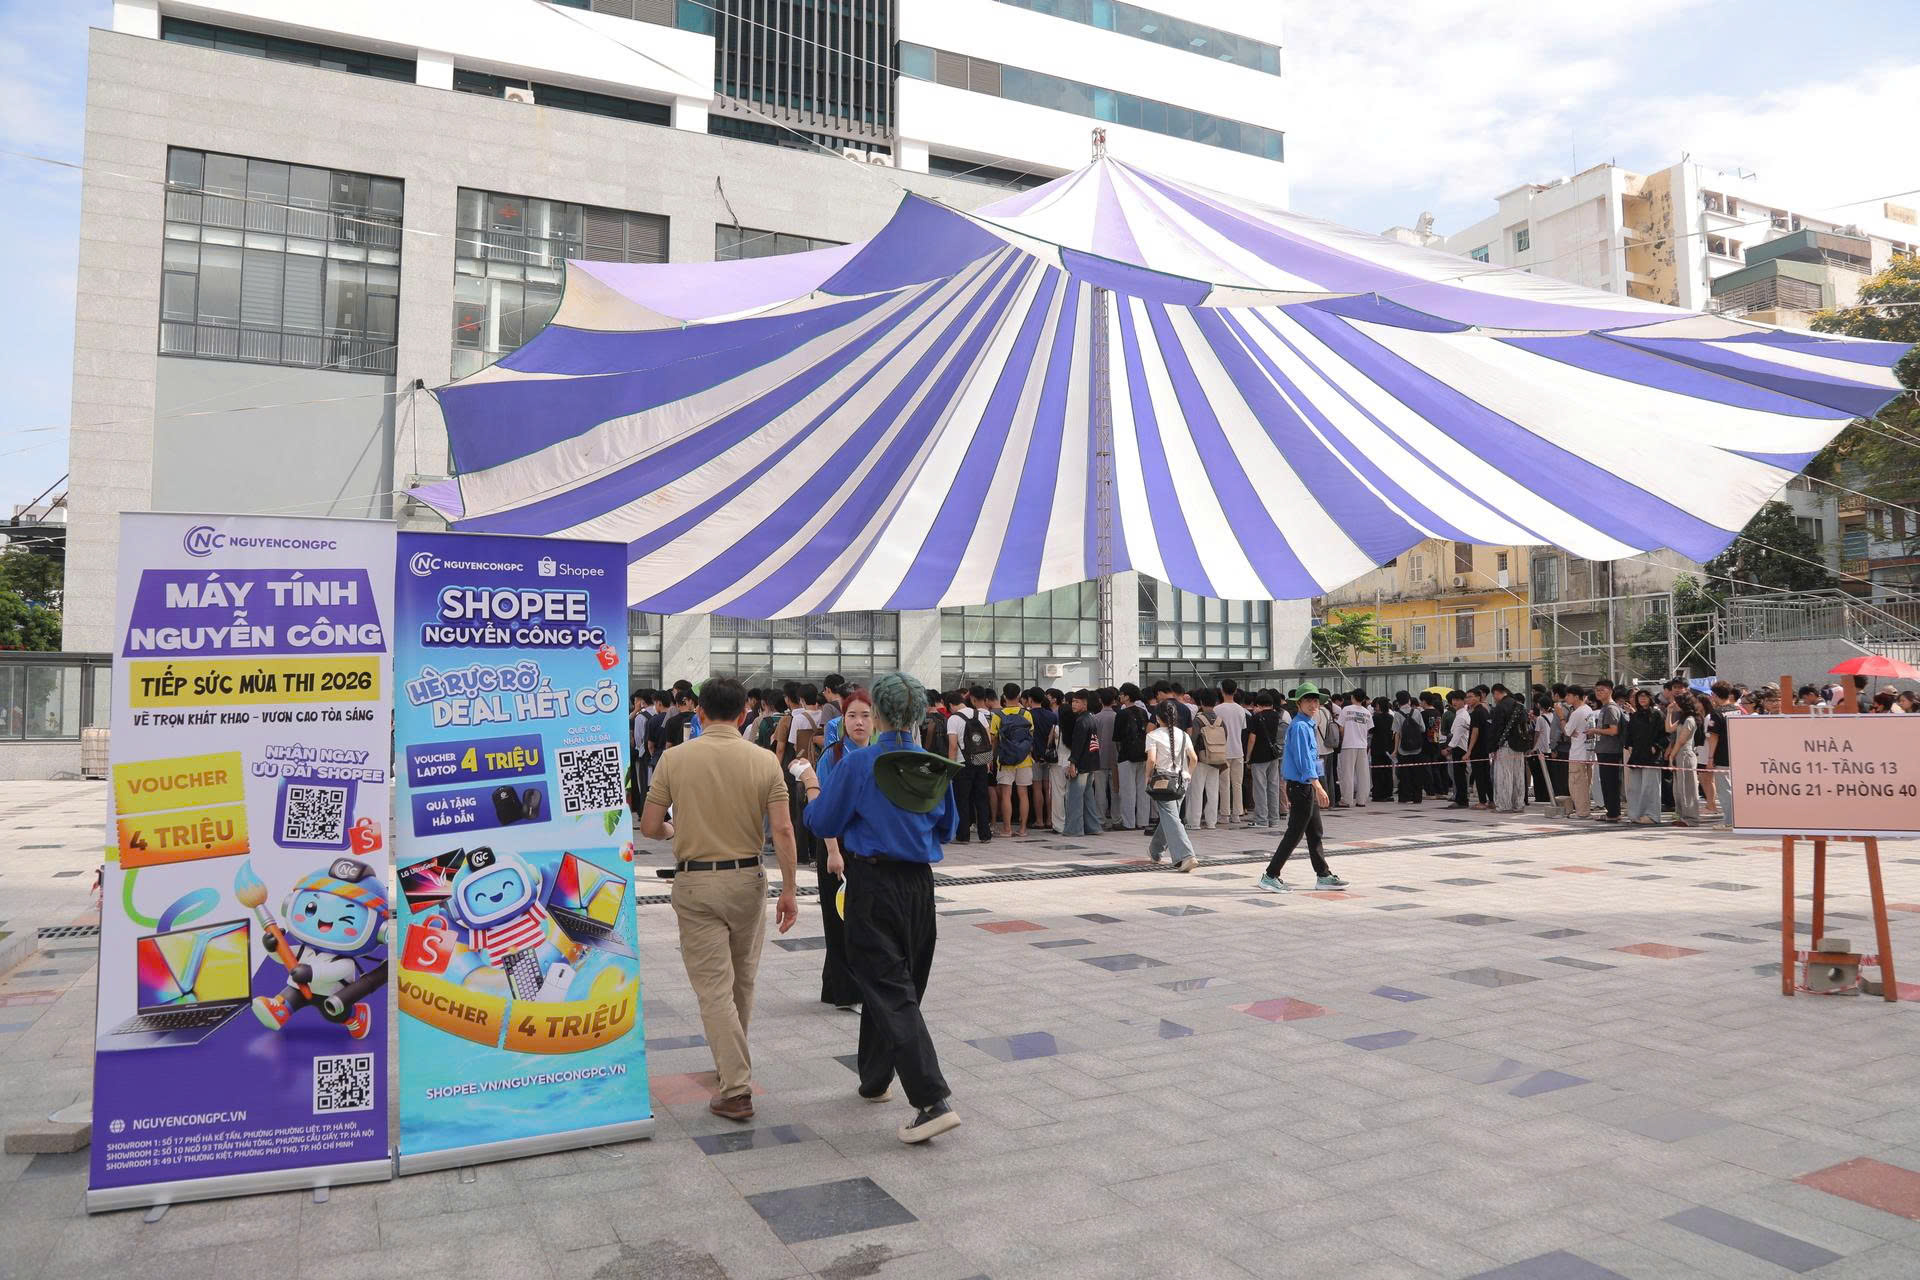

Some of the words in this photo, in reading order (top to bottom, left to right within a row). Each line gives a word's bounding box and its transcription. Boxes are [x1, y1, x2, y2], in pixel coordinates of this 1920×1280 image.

[230, 537, 337, 550] NGUYENCONGPC
[444, 560, 524, 572] NGUYENCONGPC
[559, 563, 605, 579] Shopee
[165, 572, 254, 609] MÁY
[267, 571, 358, 606] TÍNH
[442, 589, 587, 621] SHOPEE
[131, 610, 275, 650] NGUYỄN
[287, 616, 381, 646] CÔNG
[425, 622, 511, 644] NGUYỄN
[516, 626, 573, 645] CÔNG
[578, 630, 604, 645] PC
[141, 665, 187, 697] TIẾP
[194, 670, 232, 695] SỨC
[239, 669, 277, 694] MÙA
[283, 673, 314, 693] THI
[321, 672, 372, 691] 2026
[410, 669, 443, 702] HÈ
[444, 665, 496, 697] RỰC
[500, 662, 538, 690] RỠ
[433, 695, 511, 728] DEAL
[515, 679, 570, 720] HẾT
[575, 679, 619, 714] CỠ
[134, 710, 149, 726] VẼ
[153, 713, 184, 728] TRỌN
[187, 710, 217, 725] KHÁT
[220, 712, 250, 724] KHAO
[262, 711, 293, 723] VƯƠN
[296, 711, 318, 722] CAO
[345, 707, 374, 721] SÁNG
[266, 742, 317, 763] NHẬN
[320, 748, 369, 764] NGAY
[1804, 737, 1839, 753] NHÀ
[1842, 740, 1854, 753] A
[414, 752, 457, 765] VOUCHER
[461, 747, 478, 773] 4
[484, 745, 539, 772] TRIỆU
[1760, 758, 1801, 774] TẦNG
[1806, 762, 1828, 774] 11-
[1832, 758, 1875, 774] TẦNG
[1879, 762, 1898, 774] 13
[127, 769, 228, 795] VOUCHER
[252, 761, 278, 777] ƯU
[281, 762, 312, 777] ĐÃI
[317, 766, 384, 783] SHOPEE
[416, 765, 457, 778] LAPTOP
[1746, 780, 1801, 796] PHÒNG
[1806, 784, 1822, 796] 21
[1836, 781, 1894, 797] PHÒNG
[1899, 784, 1917, 797] 40
[426, 798, 449, 812] QUÀ
[450, 796, 477, 811] TẶNG
[432, 812, 451, 827] HẤP
[454, 810, 475, 825] DẪN
[129, 830, 149, 851] 4
[154, 817, 234, 849] TRIỆU
[400, 870, 410, 878] LG
[397, 975, 489, 1026] VOUCHER
[518, 1016, 537, 1037] 4
[545, 998, 628, 1039] TRIỆU
[425, 1064, 626, 1100] SHOPEE.VN/NGUYENCONGPC.VN
[133, 1110, 247, 1130] NGUYENCONGPC.VN
[106, 1140, 152, 1151] SHOWROOM
[154, 1139, 161, 1147] 1:
[162, 1136, 173, 1146] SỐ
[174, 1137, 184, 1145] 17
[106, 1150, 152, 1161] SHOWROOM
[162, 1146, 172, 1155] SỐ
[174, 1146, 183, 1154] 10
[105, 1159, 151, 1171] SHOWROOM
[160, 1157, 172, 1165] 49
